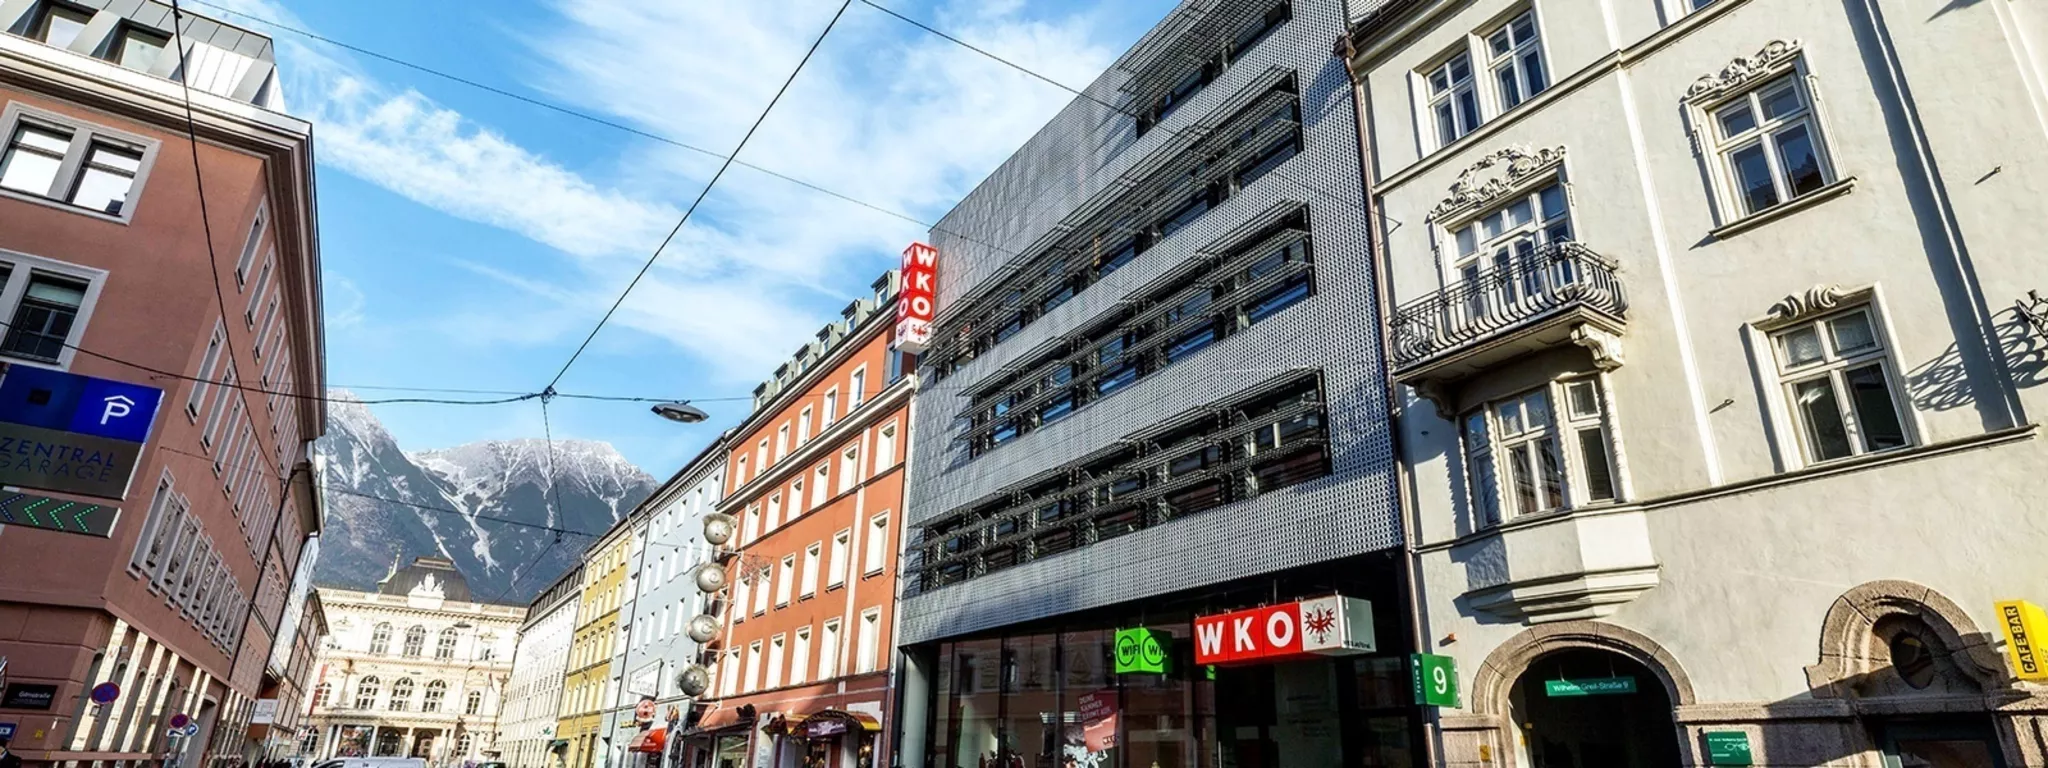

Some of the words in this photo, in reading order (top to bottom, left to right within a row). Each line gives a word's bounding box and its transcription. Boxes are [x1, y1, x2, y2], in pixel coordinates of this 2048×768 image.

[899, 247, 914, 317] WKO
[912, 245, 936, 316] WKO
[0, 437, 115, 467] ZENTRAL
[1121, 643, 1140, 656] WIFI
[1197, 610, 1295, 657] WKO
[1432, 666, 1448, 695] 9
